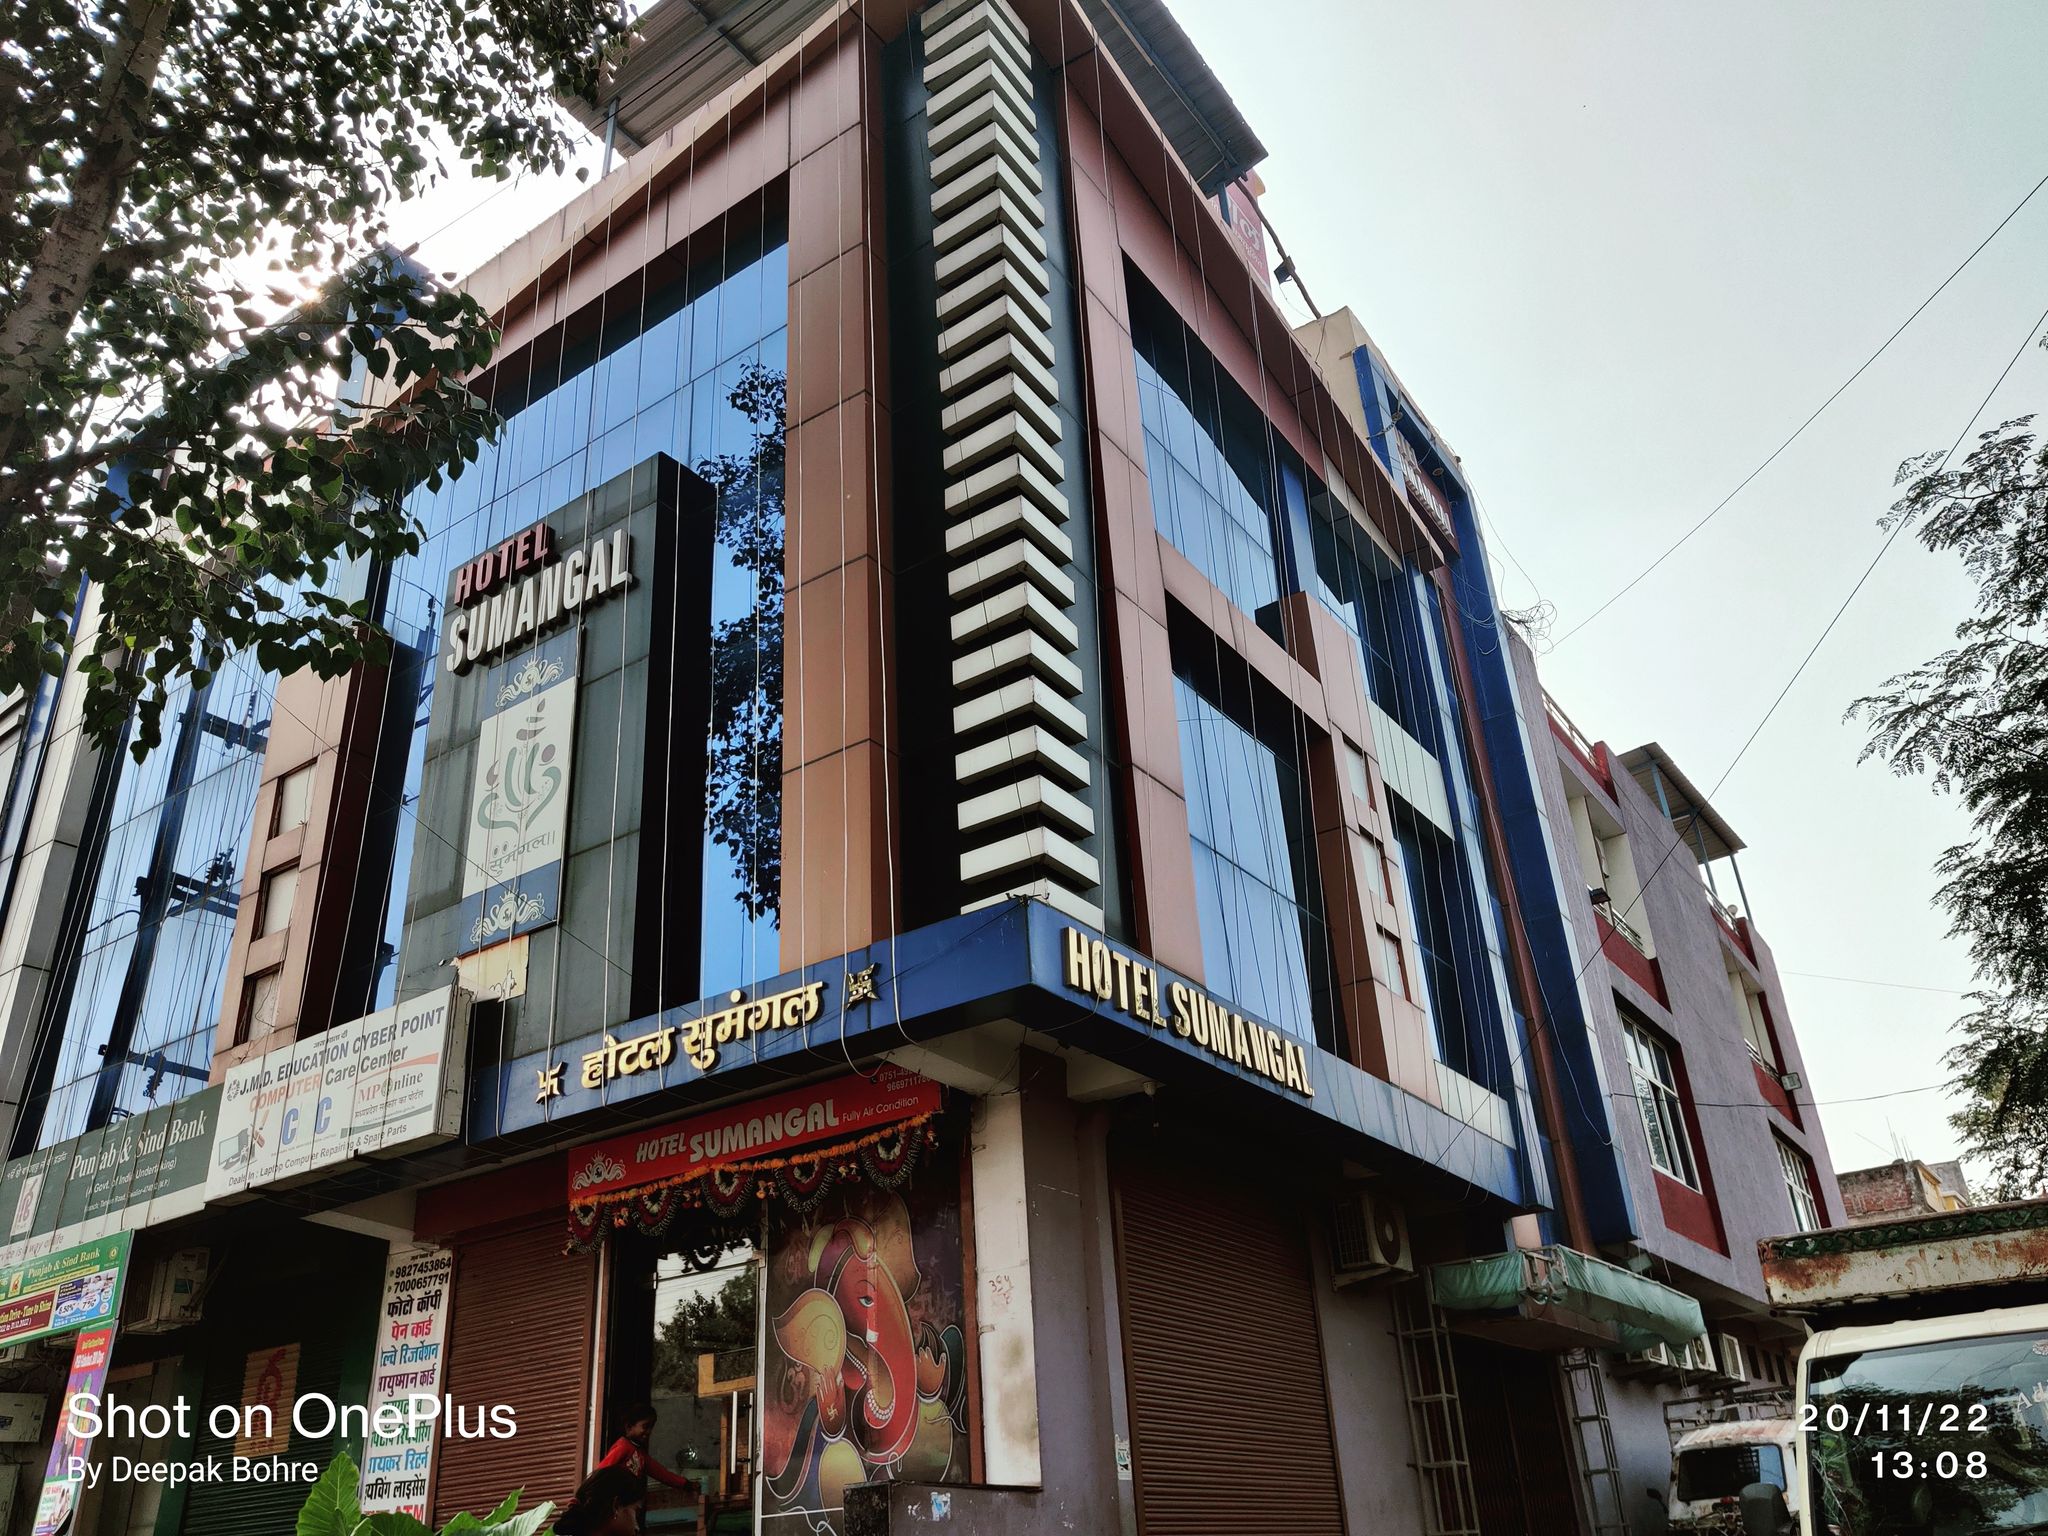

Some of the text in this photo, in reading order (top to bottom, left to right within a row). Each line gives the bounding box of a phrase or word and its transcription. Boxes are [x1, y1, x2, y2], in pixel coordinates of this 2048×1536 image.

[453, 522, 551, 606] HOTEL
[446, 528, 633, 673] SUMANGAL
[1063, 926, 1315, 1098] HOTEL SUMANGAL
[277, 1041, 350, 1083] EDUCATION
[352, 1025, 397, 1055] CYBER
[401, 1006, 445, 1038] POINT
[580, 981, 824, 1090] होटल सुमंगल
[249, 1046, 409, 1112] COMPUTER Care Center
[70, 1142, 117, 1181] Punjab
[119, 1136, 133, 1163] &
[136, 1124, 166, 1159] Sind
[168, 1110, 207, 1147] Bank
[284, 1151, 319, 1170] Computer
[320, 1141, 356, 1159] Repairing
[363, 1131, 385, 1148] Spare
[387, 1123, 407, 1138] Parts
[635, 1096, 919, 1164] HOTEL SUMANGAL Fully Air Condition
[28, 1263, 52, 1280] Punjab
[62, 1253, 79, 1268] Sind
[80, 1247, 100, 1263] Bank
[394, 1272, 450, 1294] 7000657791
[395, 1256, 452, 1279] 9827453864
[387, 1289, 442, 1318] फोटो कॉपी
[411, 1314, 433, 1338] कार्ड
[399, 1340, 440, 1365] रिजर्वेशन
[419, 1363, 437, 1387] कार्ड
[405, 1446, 430, 1471] रिटर्न
[393, 1473, 427, 1500] लाइसेंस
